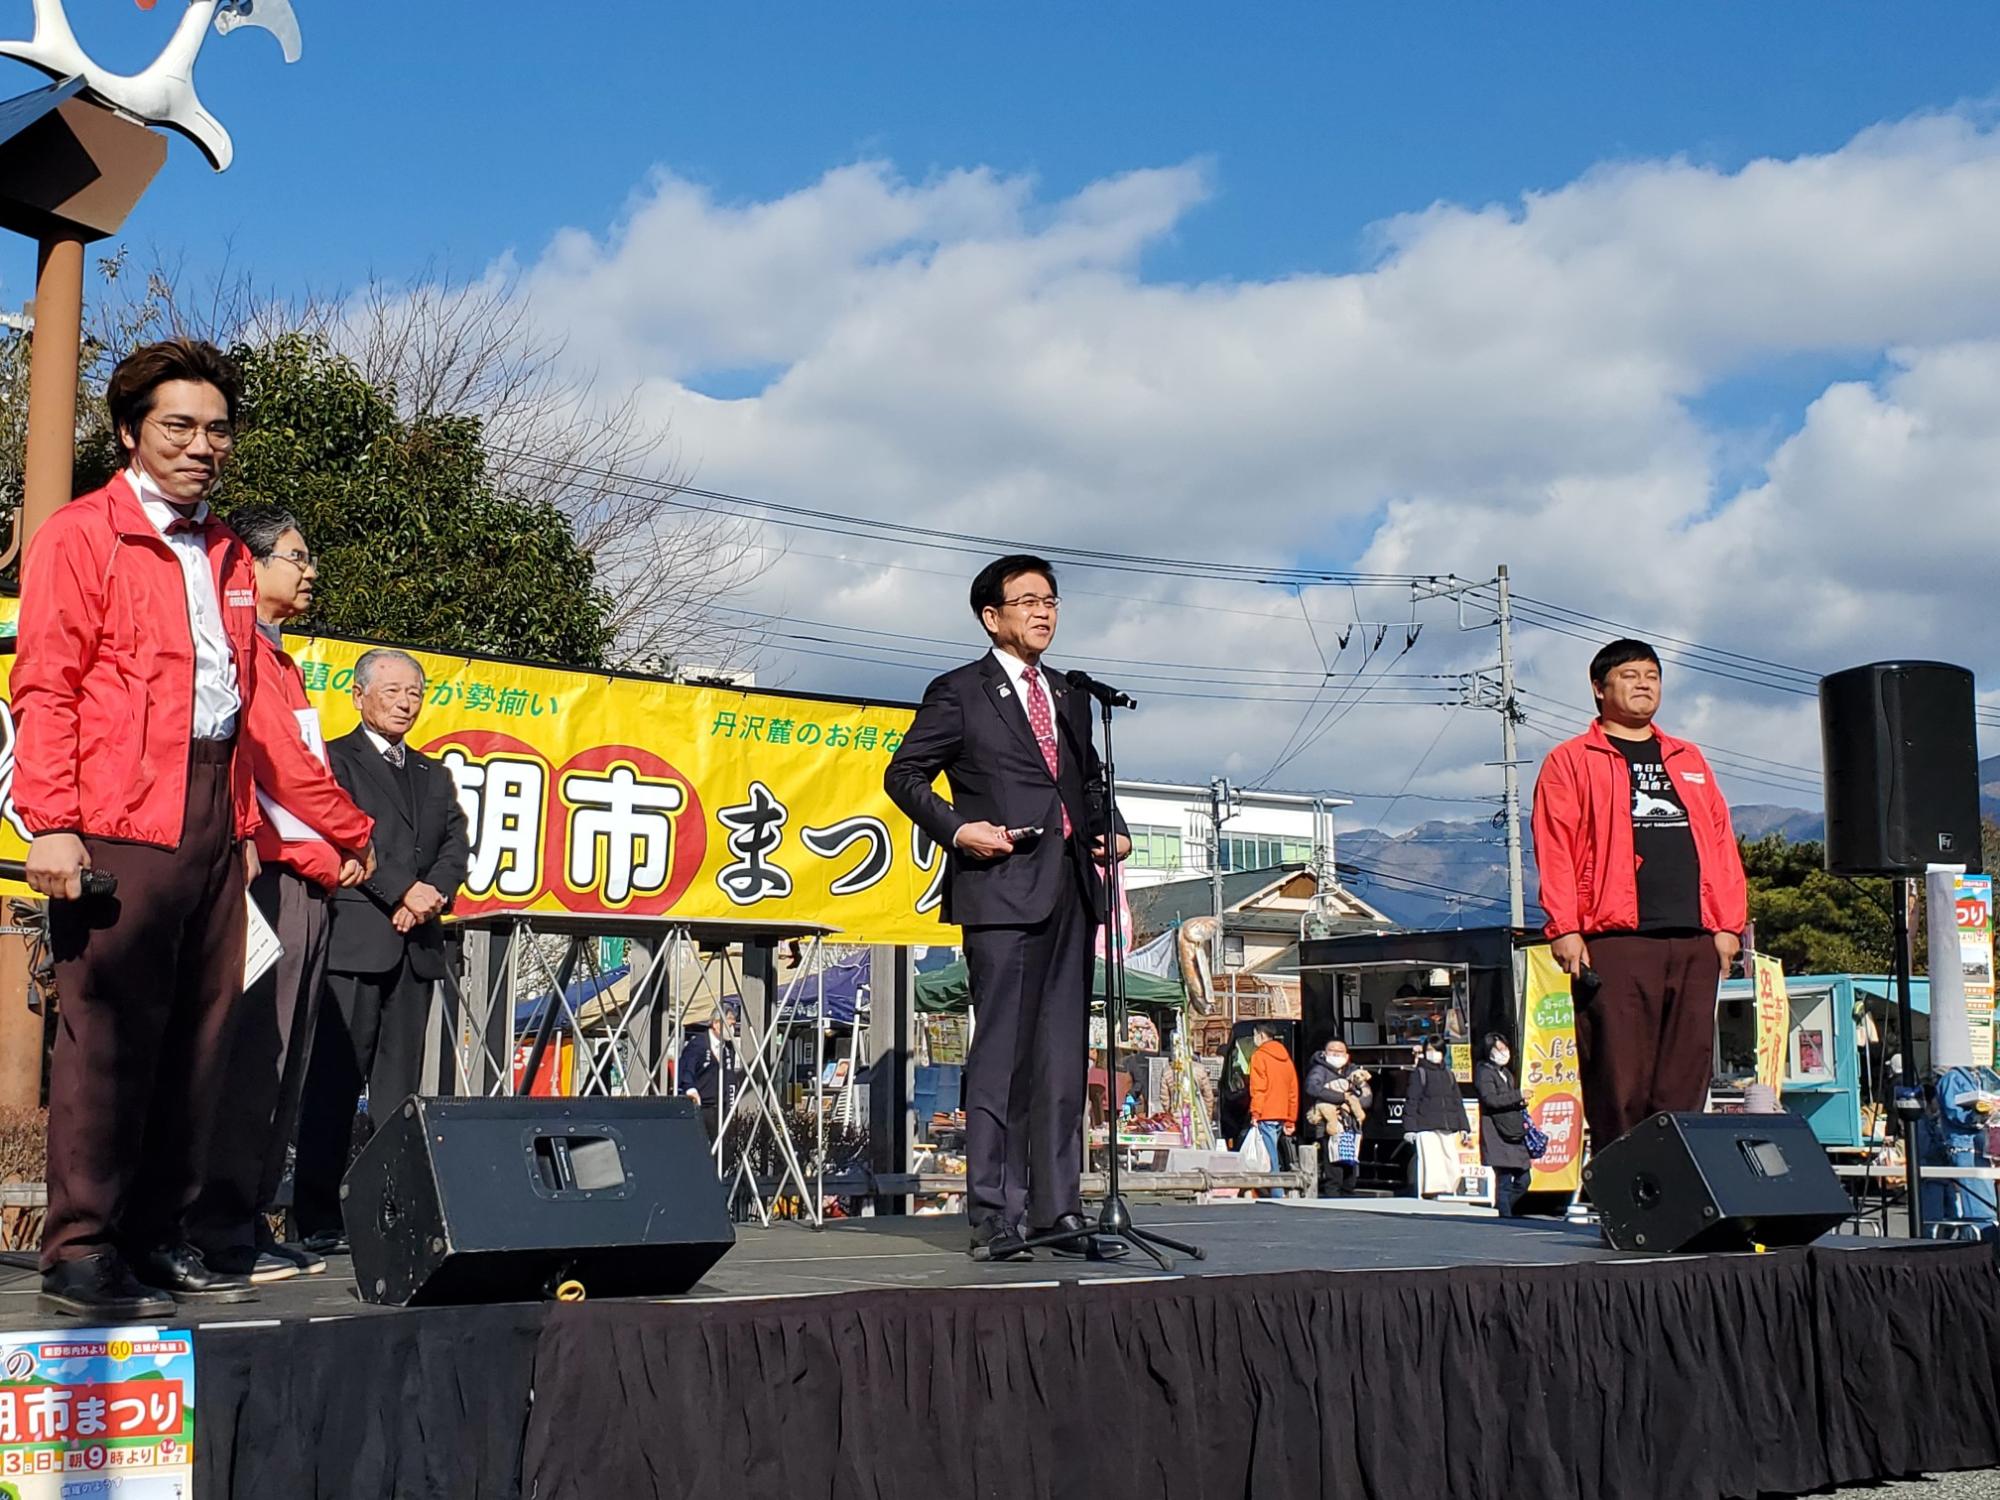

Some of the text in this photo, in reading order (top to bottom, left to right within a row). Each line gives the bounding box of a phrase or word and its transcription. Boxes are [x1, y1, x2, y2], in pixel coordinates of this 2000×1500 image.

[711, 711, 904, 753] 丹沢麓のお得な
[1387, 1104, 1405, 1117] YO
